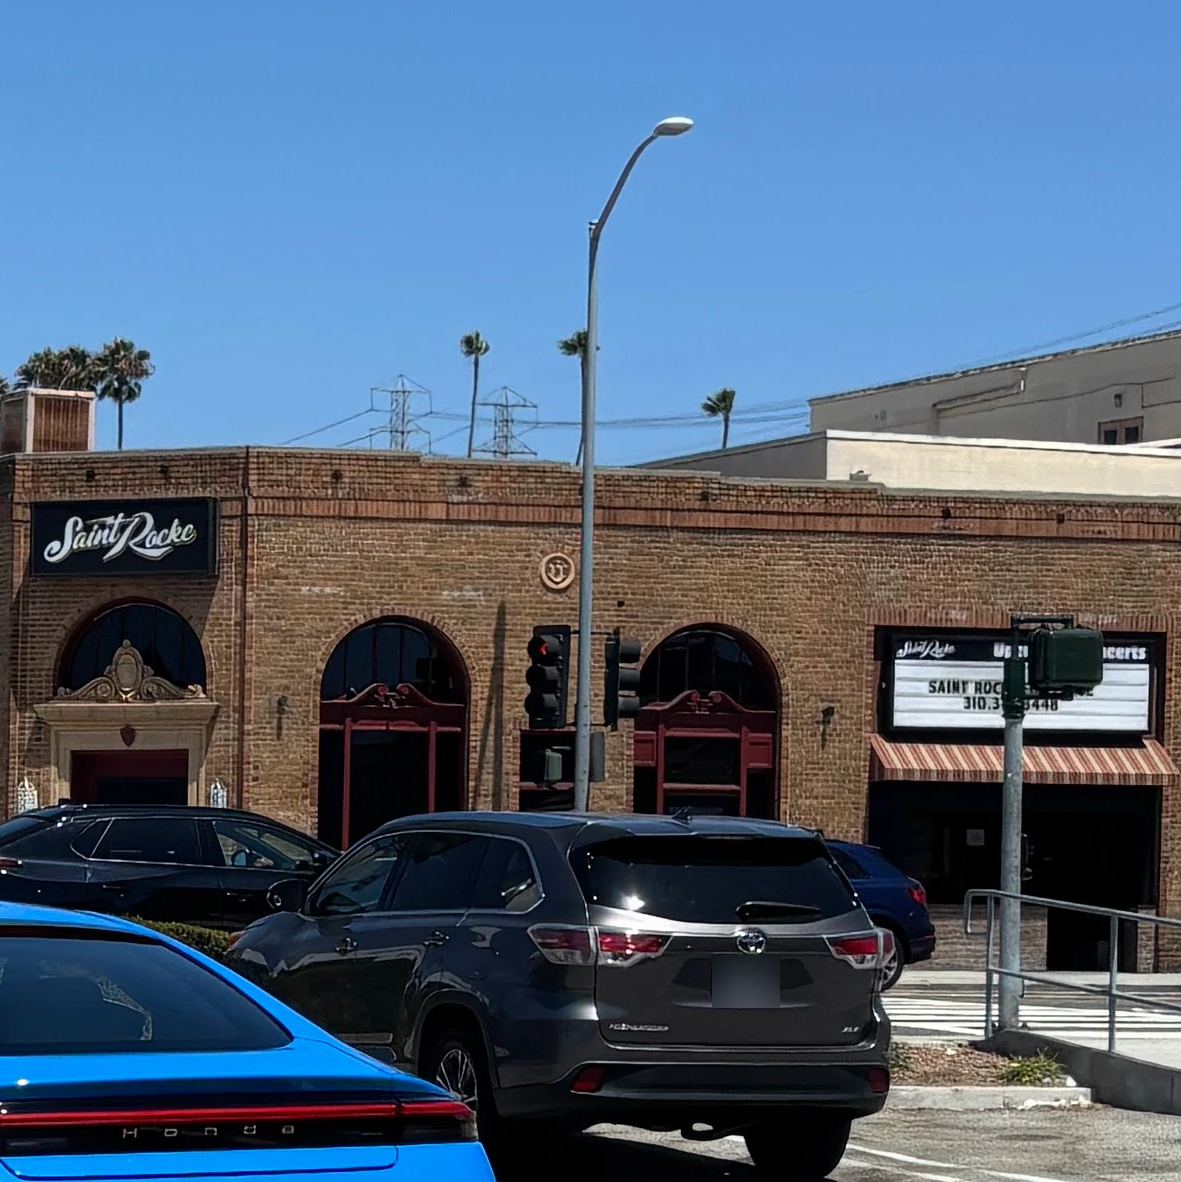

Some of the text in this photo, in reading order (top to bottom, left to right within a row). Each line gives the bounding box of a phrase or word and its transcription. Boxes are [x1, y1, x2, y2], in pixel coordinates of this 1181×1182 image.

[43, 511, 197, 563] Saint Rocke
[928, 679, 967, 695] SAINT
[122, 1124, 295, 1139] HONDA
